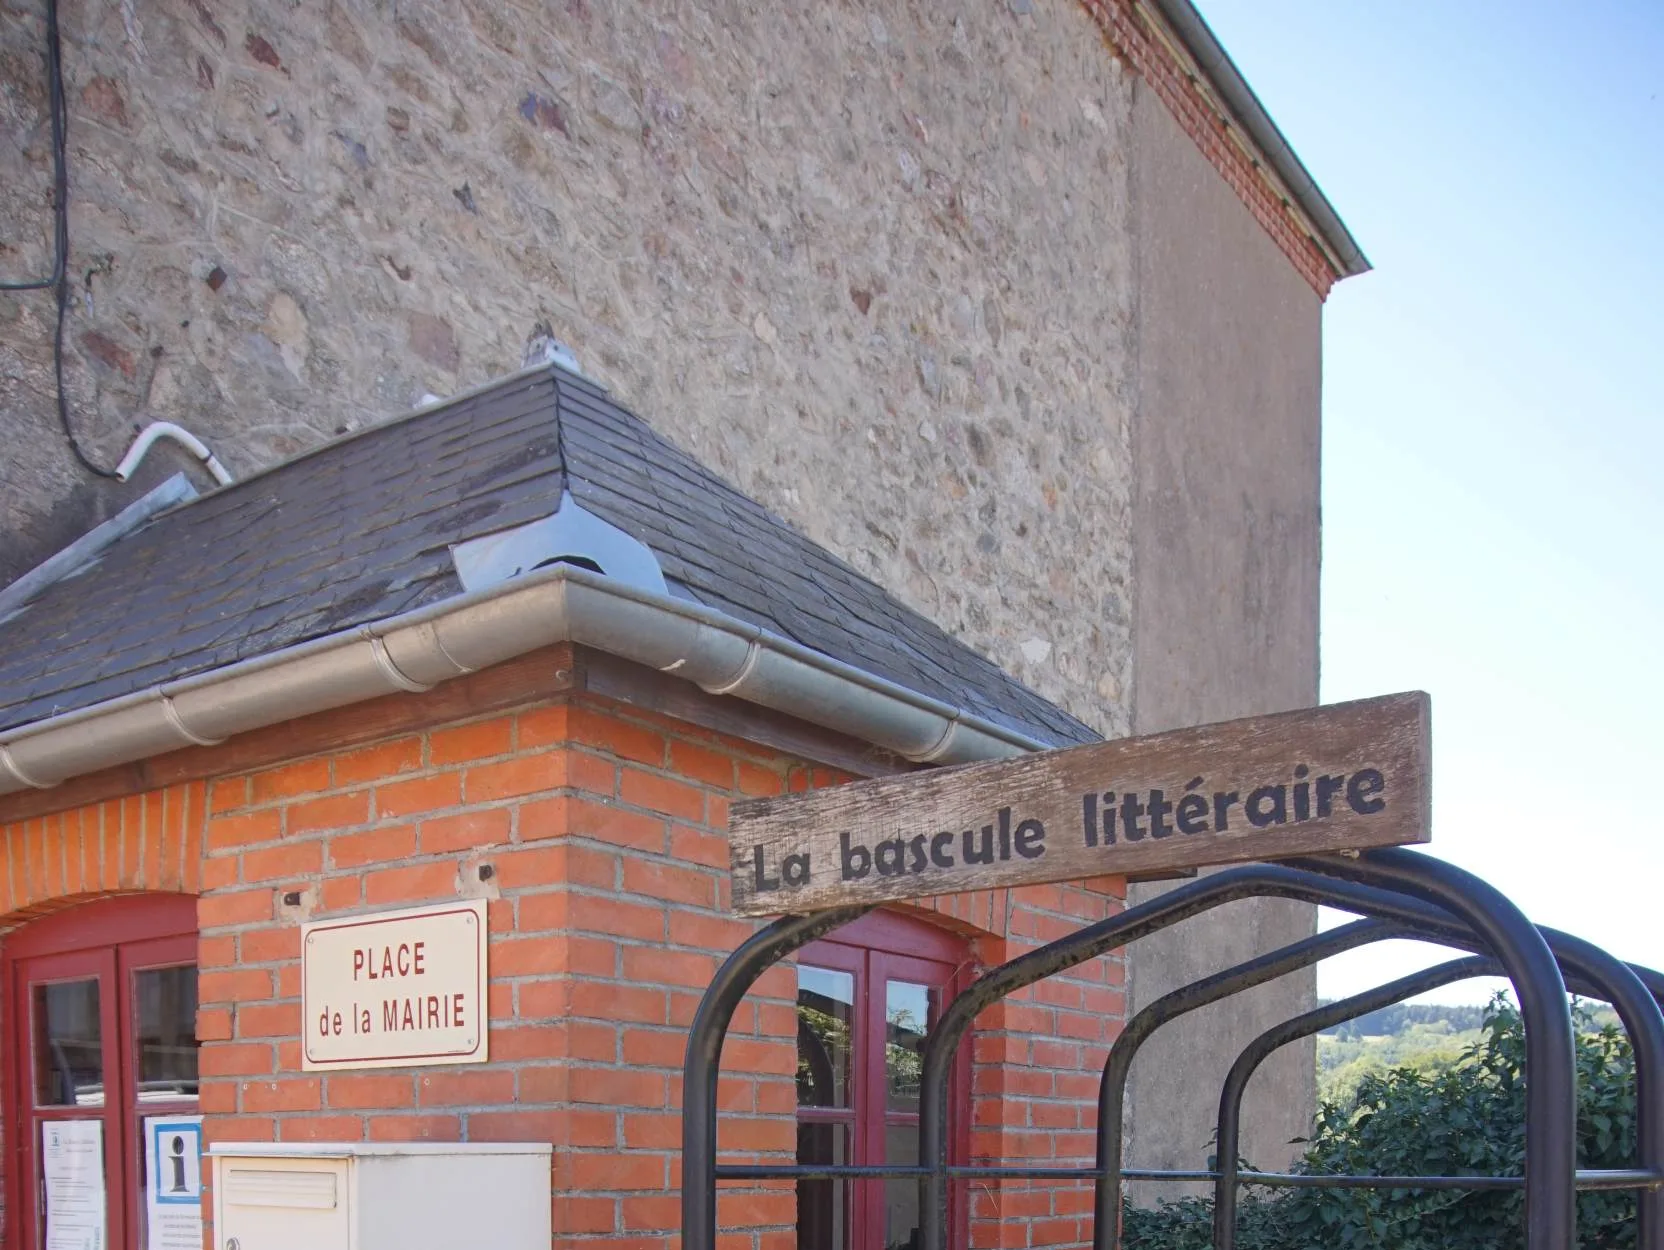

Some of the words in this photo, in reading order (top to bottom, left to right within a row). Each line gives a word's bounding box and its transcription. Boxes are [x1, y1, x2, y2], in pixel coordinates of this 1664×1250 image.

[755, 843, 810, 892] La
[840, 806, 1046, 882] bascule
[1083, 764, 1386, 847] littéraire
[354, 942, 425, 981] PLACE
[319, 1006, 343, 1037] de
[353, 1003, 371, 1034] la
[383, 994, 465, 1033] MAIRIE
